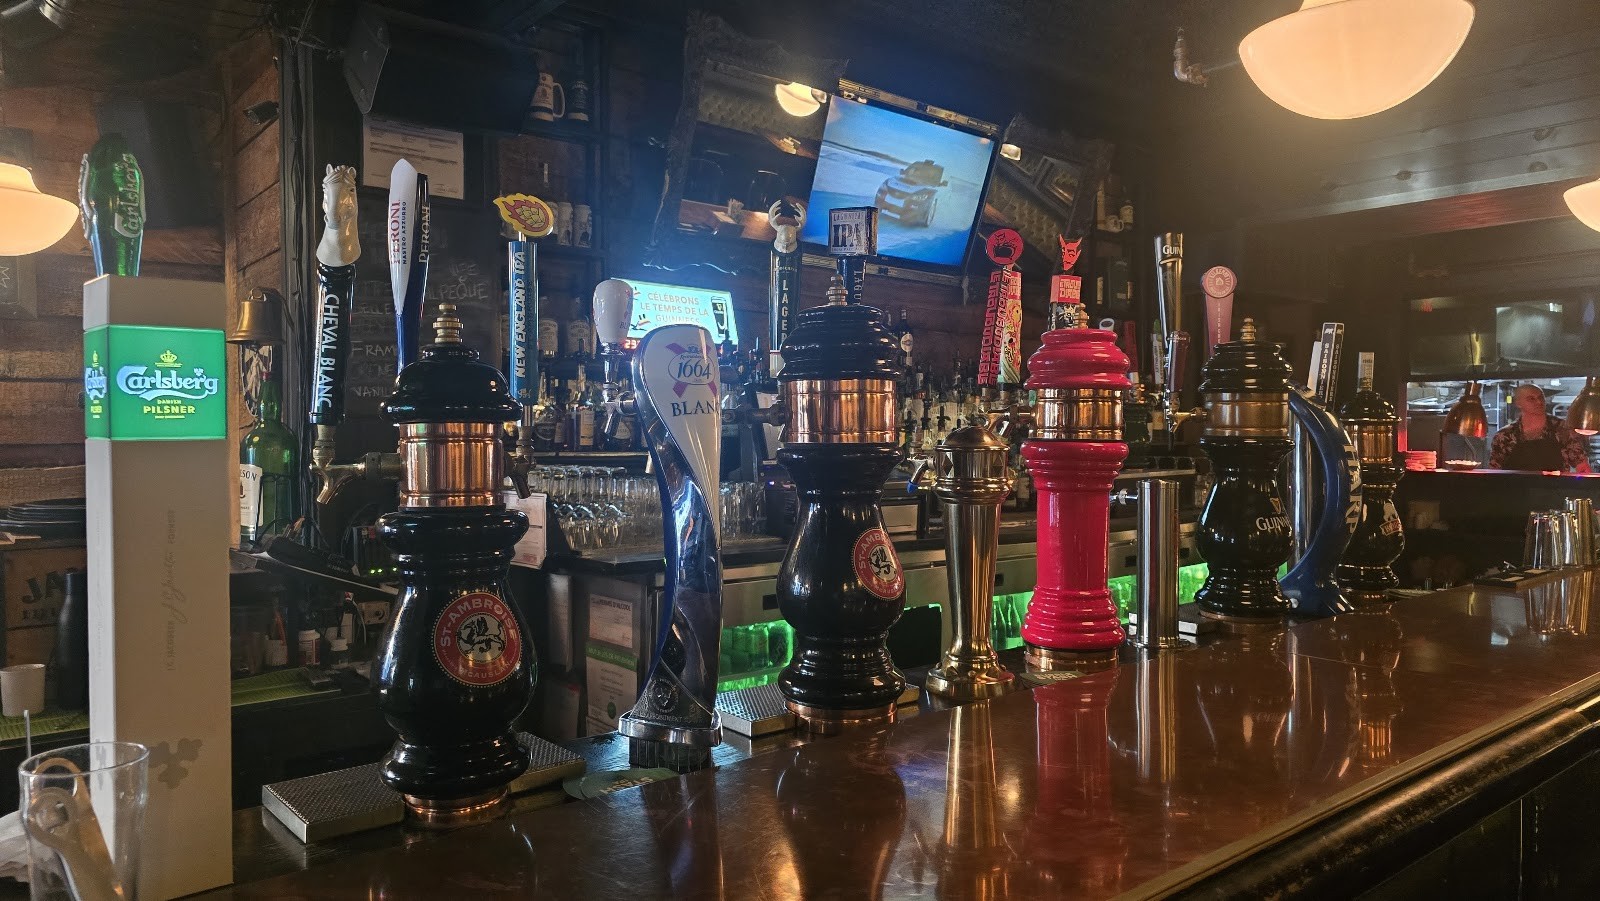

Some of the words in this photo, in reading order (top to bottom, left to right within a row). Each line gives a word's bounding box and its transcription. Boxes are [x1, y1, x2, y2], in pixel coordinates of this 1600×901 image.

[513, 250, 525, 276] IPA
[1163, 244, 1181, 256] GUIN
[514, 277, 526, 338] ENGLAND
[640, 302, 651, 311] LE
[652, 304, 683, 314] TEMPS
[685, 306, 697, 315] DE
[698, 307, 710, 317] LA
[647, 291, 700, 306] CÉLÉBRONS
[781, 279, 789, 343] LAGER
[321, 293, 340, 353] CHEVAL
[624, 339, 641, 349] 23
[514, 348, 526, 379] NEW
[677, 359, 712, 379] 1664
[116, 365, 219, 401] Carlsberg
[317, 356, 336, 408] BLANC
[143, 405, 196, 414] PILSNER
[670, 400, 719, 418] BLAN
[440, 597, 517, 648] ST-AMBROISE
